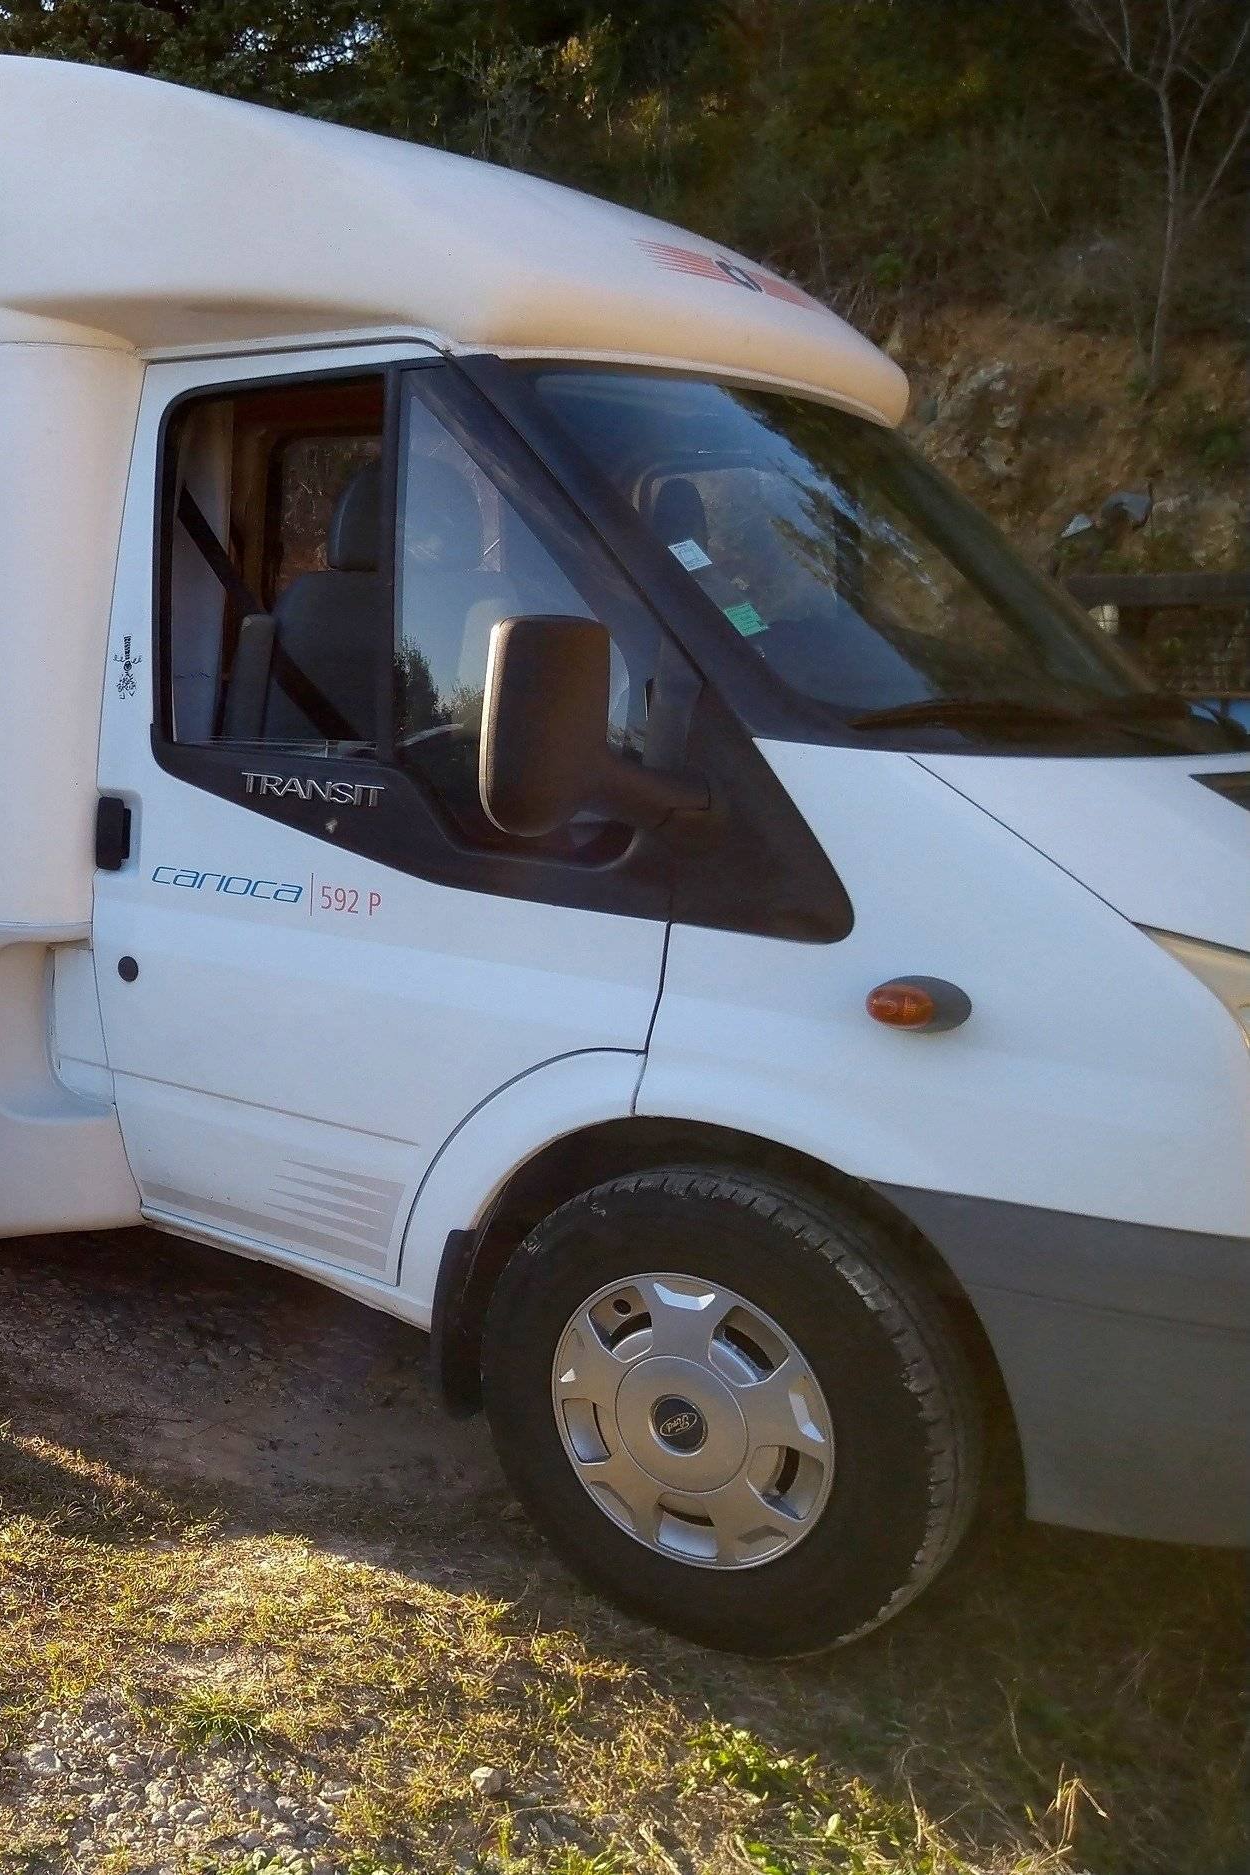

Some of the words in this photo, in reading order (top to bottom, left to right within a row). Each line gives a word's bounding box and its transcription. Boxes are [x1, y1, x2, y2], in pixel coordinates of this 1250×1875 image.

[242, 772, 386, 807] TRANSIT
[152, 866, 303, 903] carioca
[320, 885, 358, 914] 592
[369, 892, 383, 916] P
